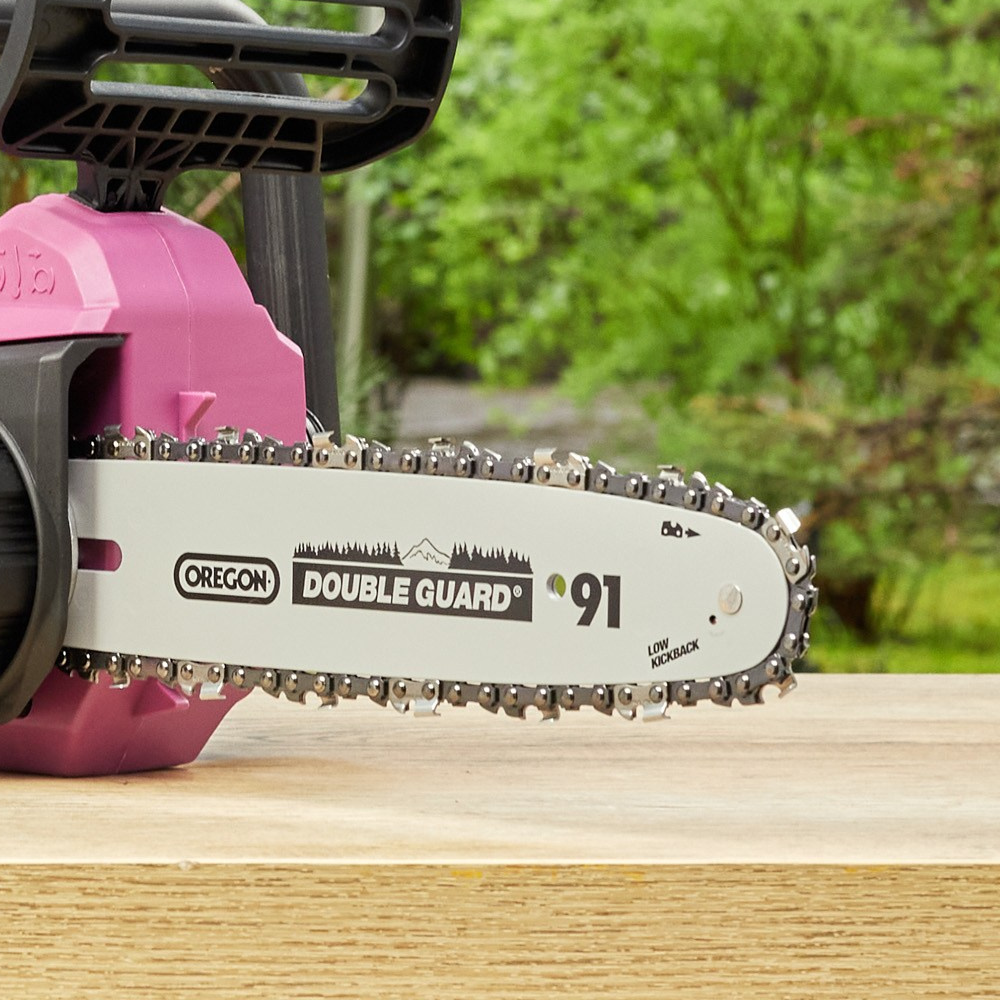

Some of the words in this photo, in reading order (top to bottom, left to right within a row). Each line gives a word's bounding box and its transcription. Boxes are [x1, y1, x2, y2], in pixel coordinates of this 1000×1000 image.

[185, 564, 267, 592] OREGON
[302, 570, 411, 606] DOUBLE
[570, 572, 621, 629] 91
[647, 637, 669, 656] LOW
[650, 638, 700, 669] KICKBACK
